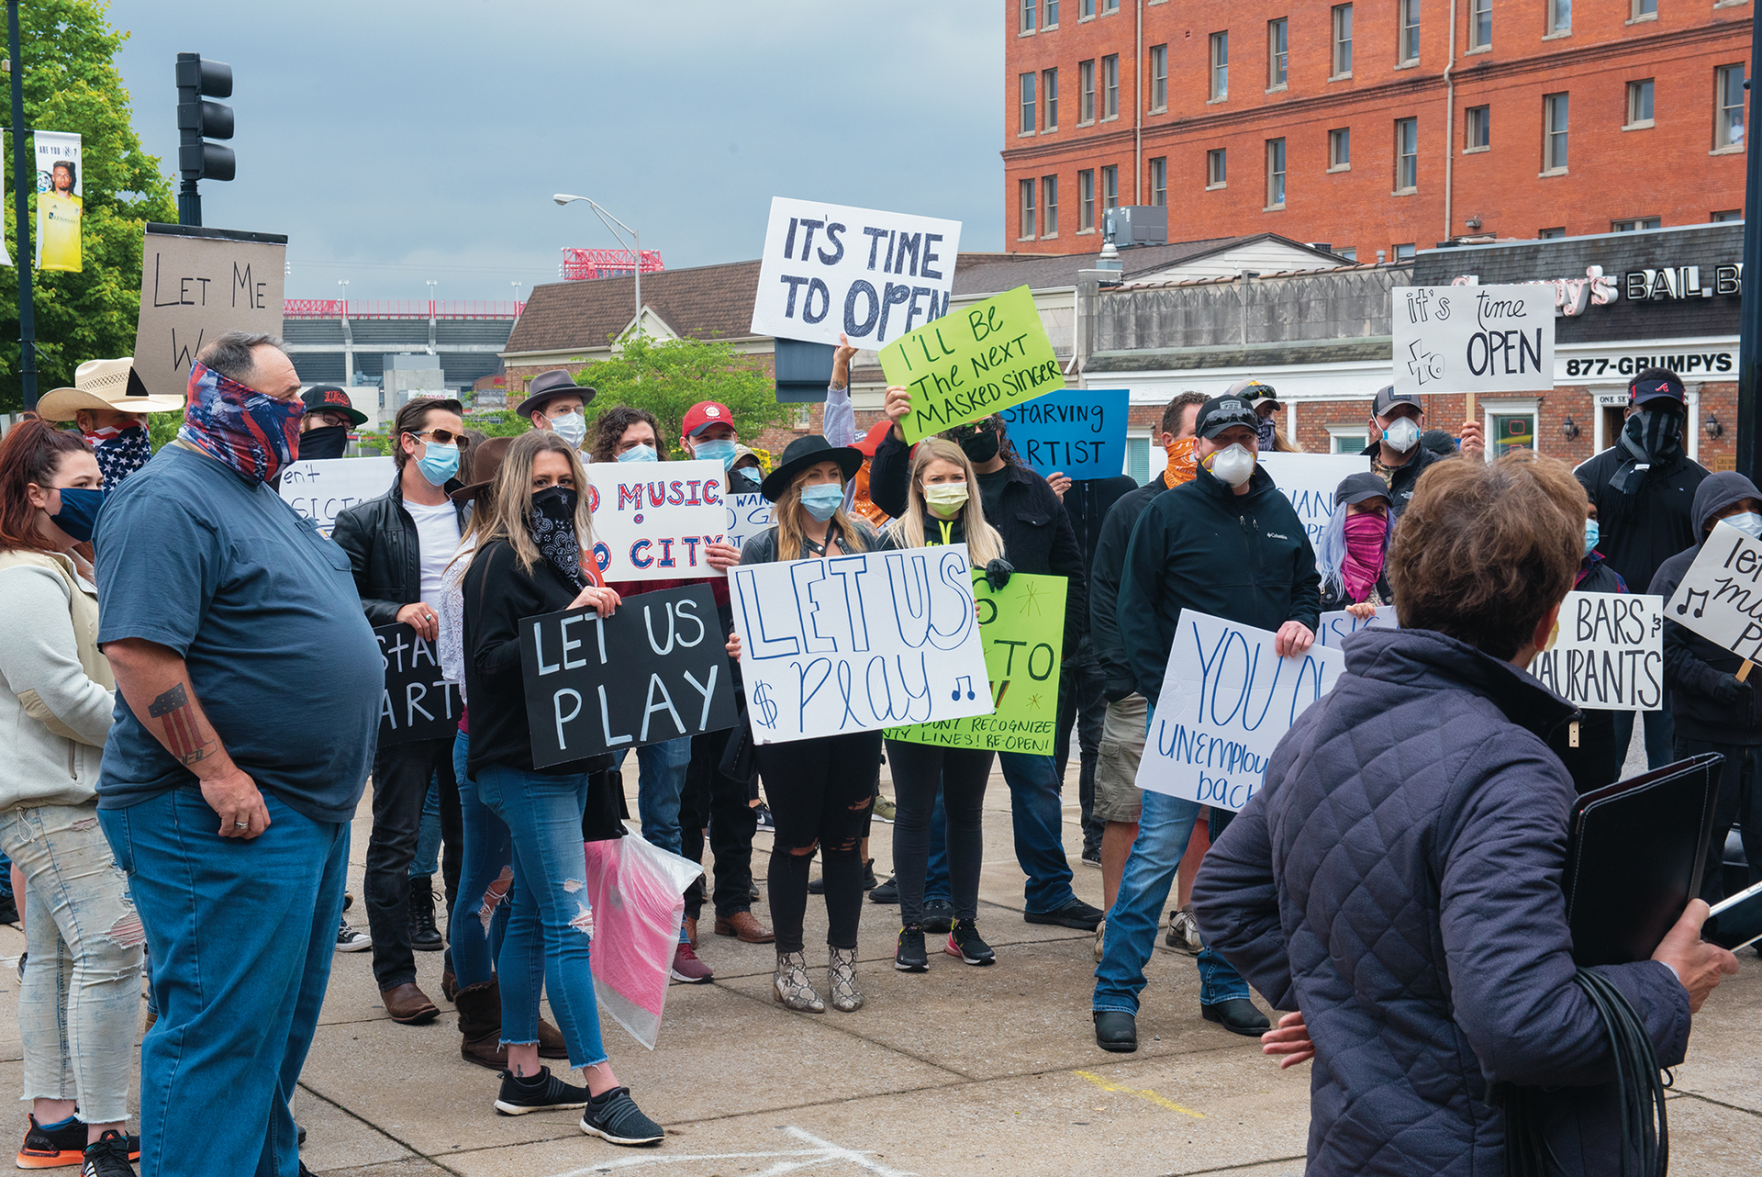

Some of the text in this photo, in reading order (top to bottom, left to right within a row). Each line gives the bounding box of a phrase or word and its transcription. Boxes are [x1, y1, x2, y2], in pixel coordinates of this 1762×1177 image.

[784, 214, 944, 281] IT'S TIME
[154, 252, 211, 307] LET
[780, 274, 951, 342] TO OPEN
[1406, 288, 1527, 333] it's time
[172, 328, 204, 372] W
[1466, 327, 1543, 377] OPEN
[1565, 353, 1733, 377] 877-GRUMPYS
[617, 478, 724, 512] MUSIC,
[736, 494, 770, 507] WAN
[735, 554, 870, 660] LET
[884, 551, 974, 651] US
[1576, 597, 1646, 645] BARS
[533, 598, 705, 676] LET US
[993, 638, 1055, 682] TO
[1192, 620, 1284, 731] YOU
[381, 679, 460, 730] ART
[553, 663, 719, 750] PLAY
[970, 716, 1057, 735] RECOGNIZE
[881, 728, 1050, 754] NTY LINES! RE-OPEN!
